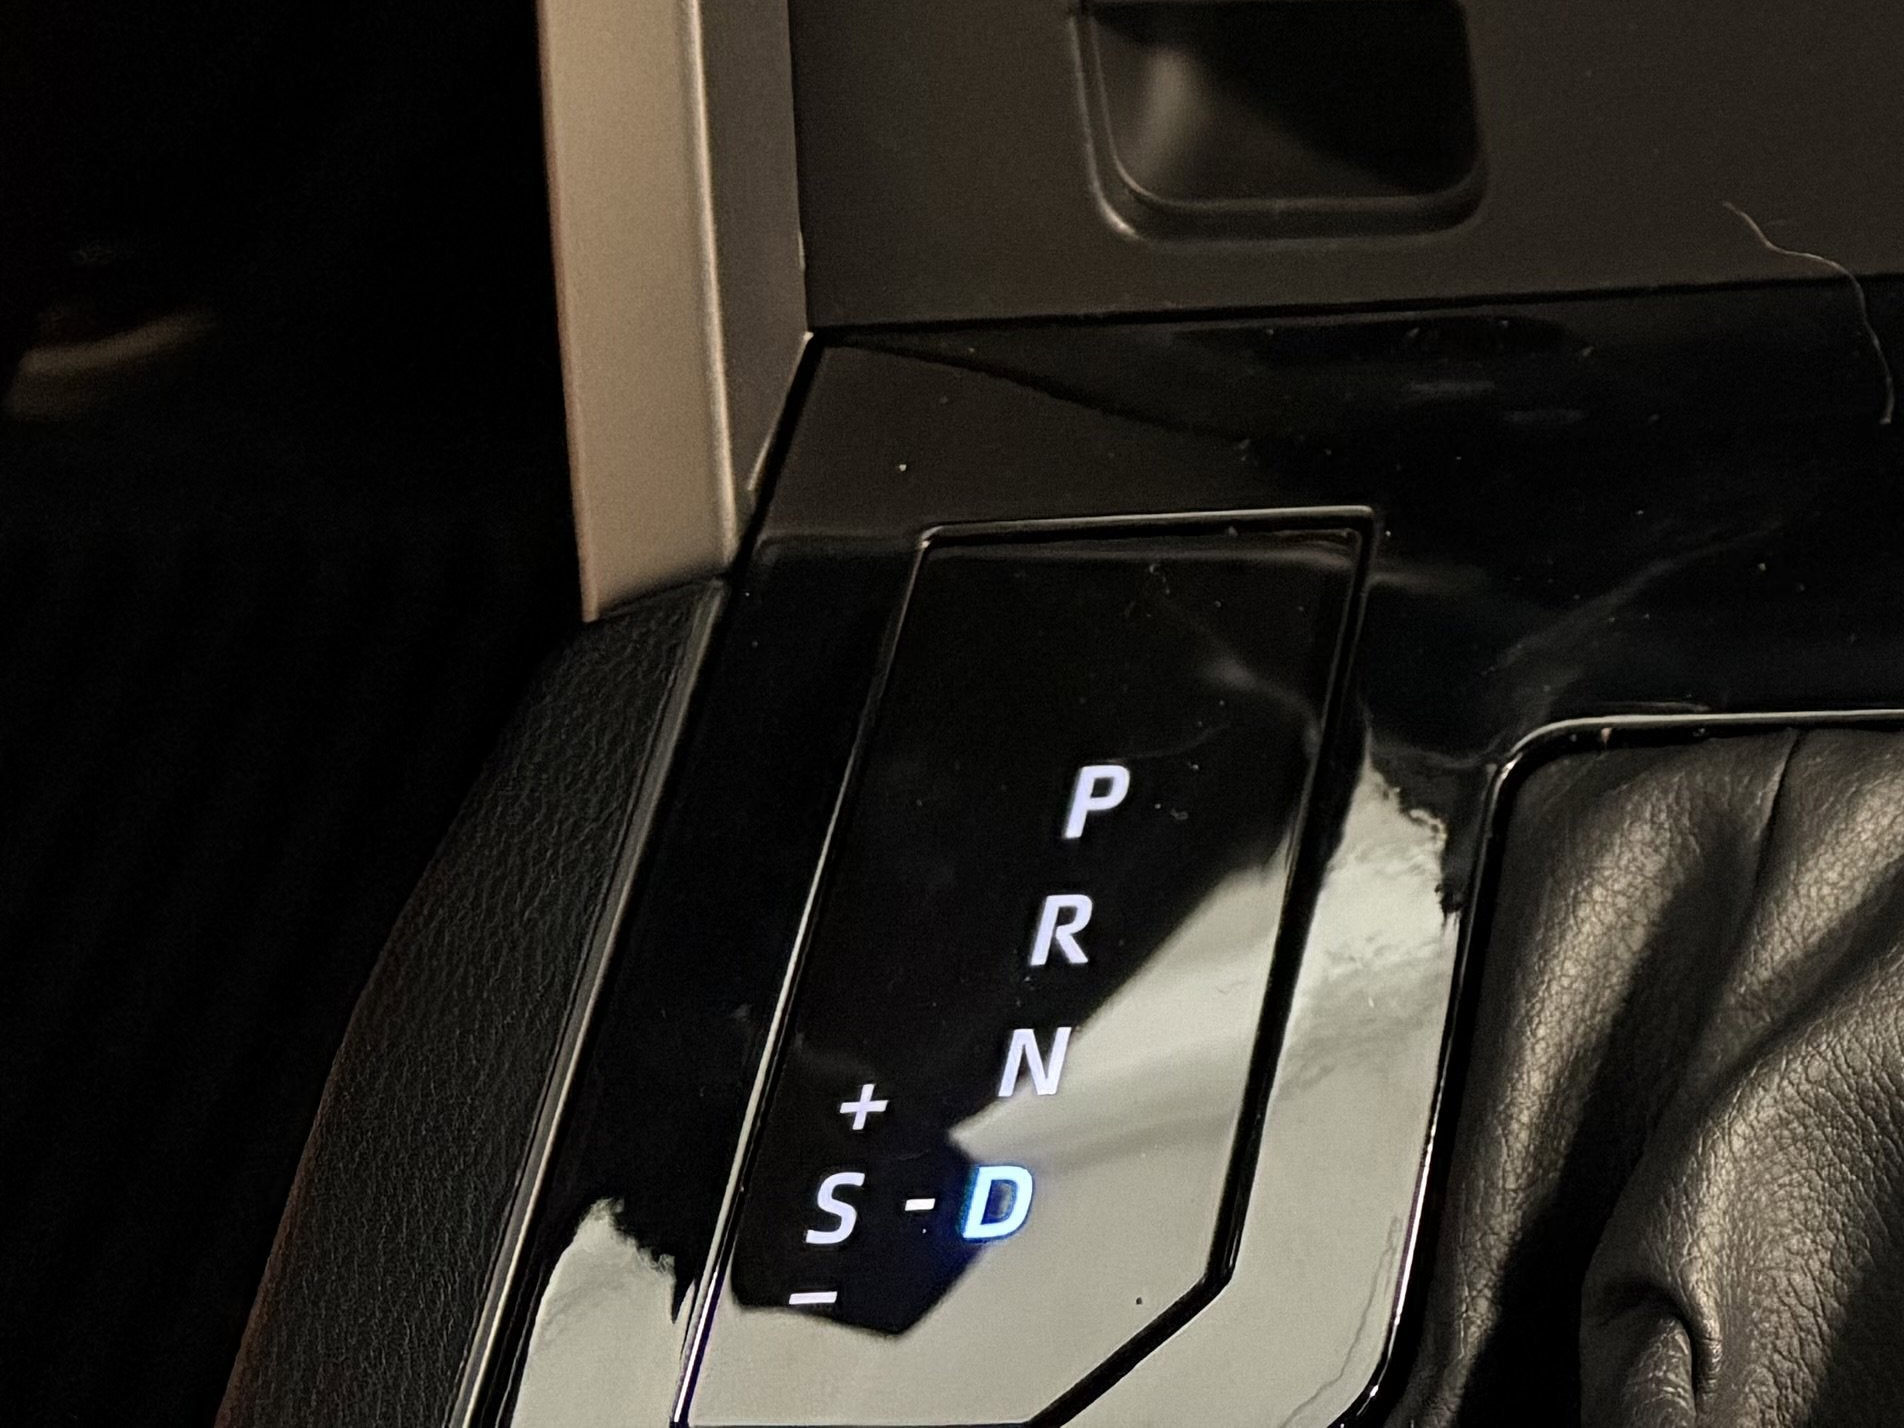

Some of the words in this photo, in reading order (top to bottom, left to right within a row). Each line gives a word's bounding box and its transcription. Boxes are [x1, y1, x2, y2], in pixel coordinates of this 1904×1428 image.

[1064, 764, 1130, 841] P
[1029, 894, 1092, 967] R
[999, 1027, 1070, 1097] N
[805, 1172, 865, 1246] S
[960, 1165, 1035, 1241] D
